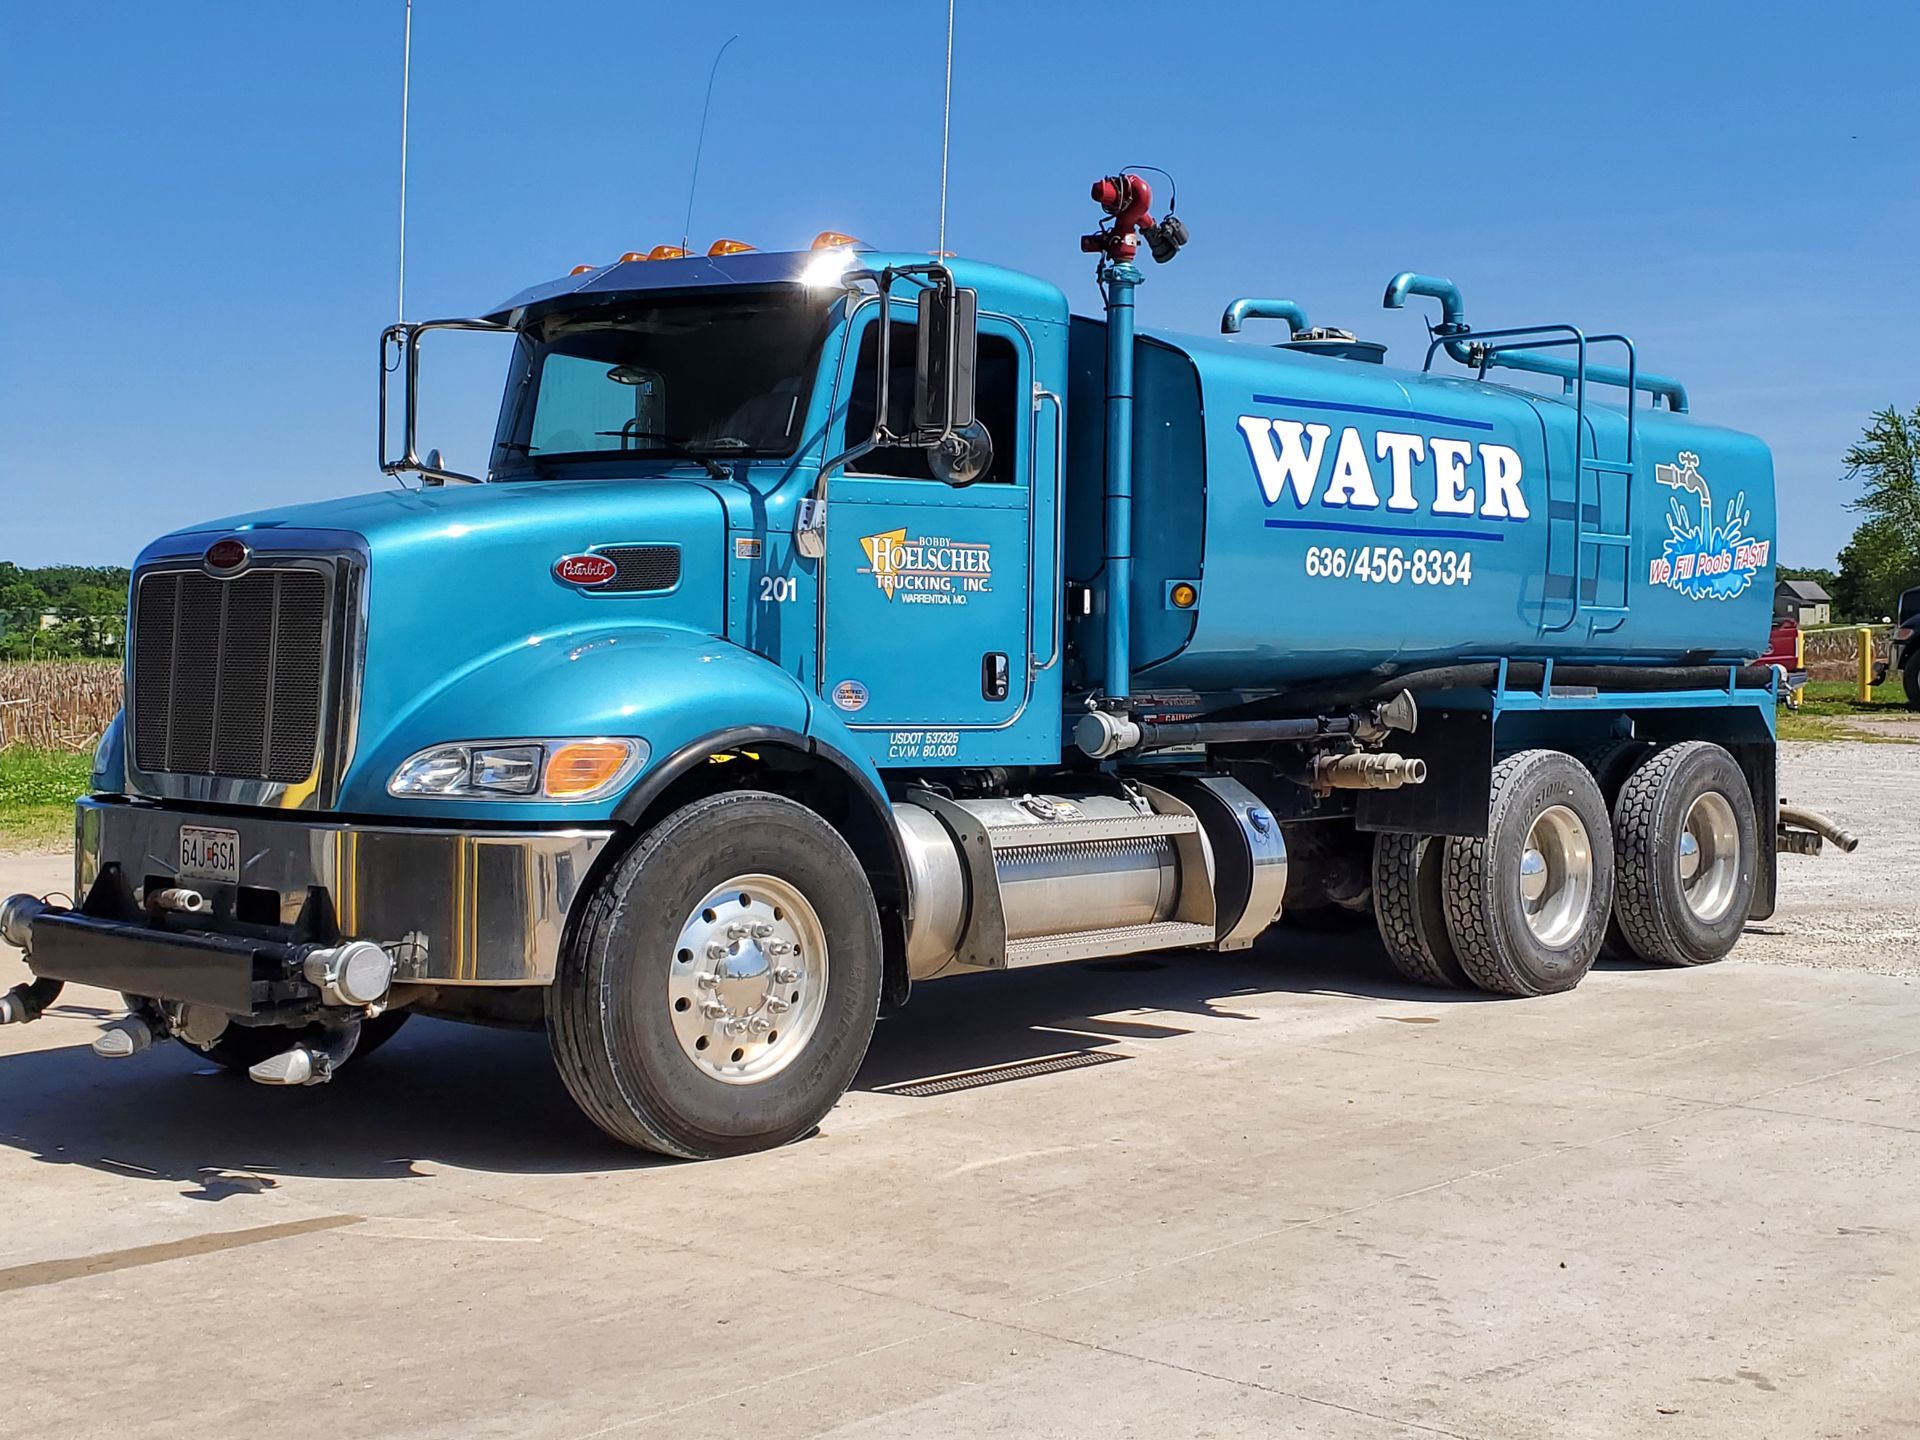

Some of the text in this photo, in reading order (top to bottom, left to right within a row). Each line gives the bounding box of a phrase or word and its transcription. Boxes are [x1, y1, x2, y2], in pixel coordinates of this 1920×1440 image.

[1237, 415, 1531, 520] WATER
[919, 536, 951, 547] BOBBY
[870, 537, 992, 572] HOELSCHER
[1649, 541, 1769, 584] We Fill Pools FAST!
[563, 560, 611, 577] Peterbilt
[1305, 546, 1472, 586] 636/456-8334
[760, 576, 797, 602] 201
[875, 574, 993, 593] TRUCKING, INC.
[901, 593, 951, 605] WARRENTON,
[890, 732, 960, 744] USDOT 537325
[923, 745, 958, 758] 80,000
